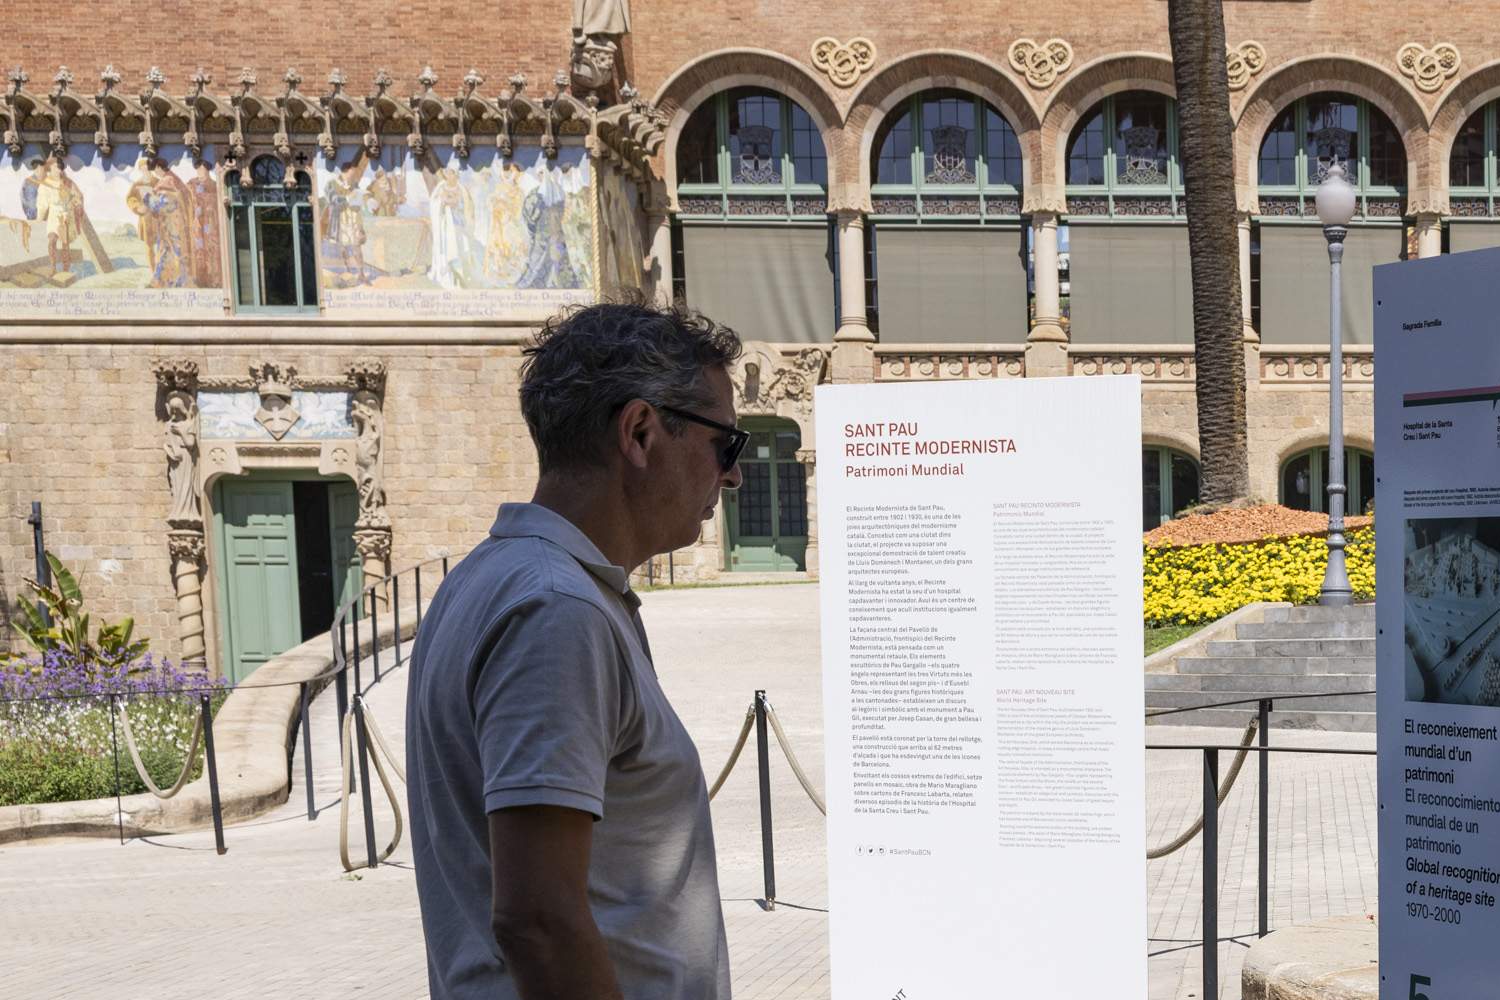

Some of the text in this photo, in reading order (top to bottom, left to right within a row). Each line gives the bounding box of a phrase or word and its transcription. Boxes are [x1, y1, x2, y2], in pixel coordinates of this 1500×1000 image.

[1403, 321, 1423, 331] Sagrada
[845, 422, 917, 438] SANT PAU
[1403, 422, 1423, 430] Hospital
[1437, 420, 1453, 428] Santa
[1403, 433, 1415, 441] Creu
[1418, 432, 1430, 440] Sant
[1431, 431, 1441, 439] Pau
[846, 439, 1016, 457] RECINTE MODERNISTA
[846, 463, 964, 477] Patrimoni Mundial
[1404, 719, 1497, 740] El reconeixement
[1405, 744, 1472, 762] mundial d'un
[1405, 766, 1454, 784] patrimoni
[1405, 788, 1415, 803] El
[1405, 814, 1479, 834] mundial de un
[1406, 836, 1461, 855] patrimonio
[1406, 857, 1440, 875] Global
[1406, 880, 1495, 907] of a heritage site
[1406, 902, 1461, 925] 1970-2000
